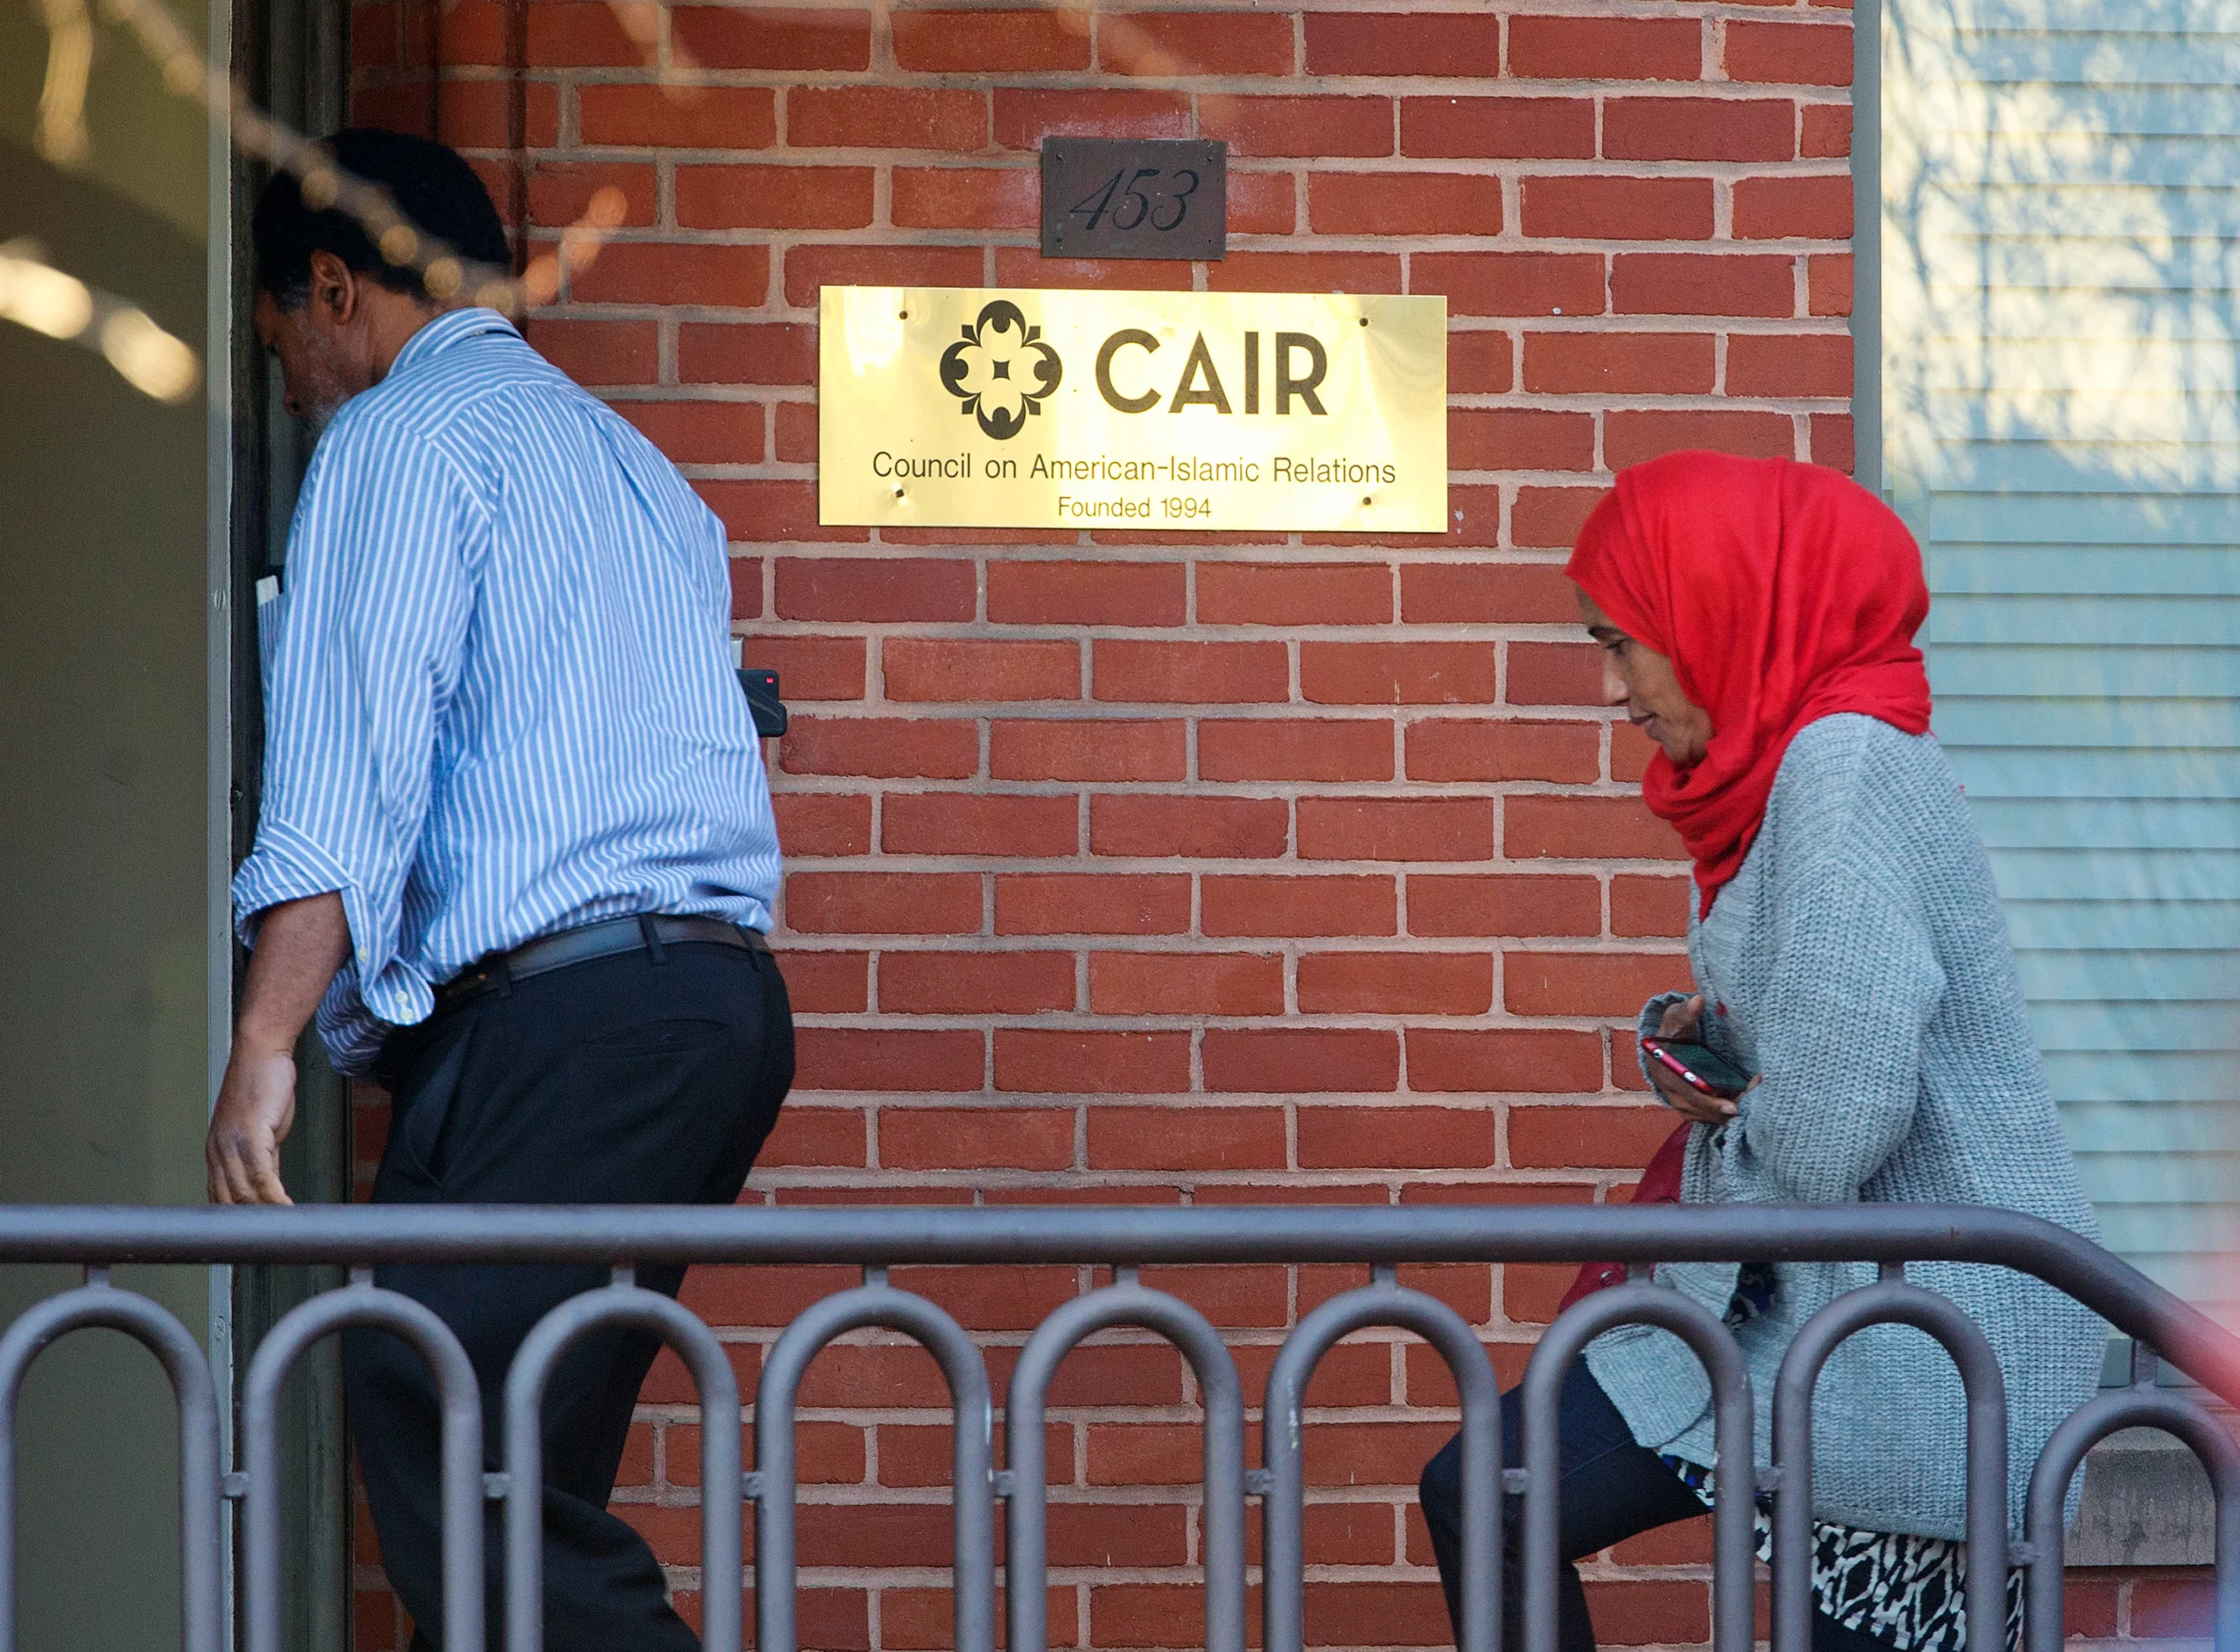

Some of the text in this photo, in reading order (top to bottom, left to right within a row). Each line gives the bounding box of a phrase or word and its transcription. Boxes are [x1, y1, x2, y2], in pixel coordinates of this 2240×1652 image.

[1069, 168, 1200, 231] 453
[1096, 328, 1328, 416] CAIR
[872, 451, 1396, 484] Council on American-Islamic Relations
[1058, 496, 1211, 519] Founded 1994
